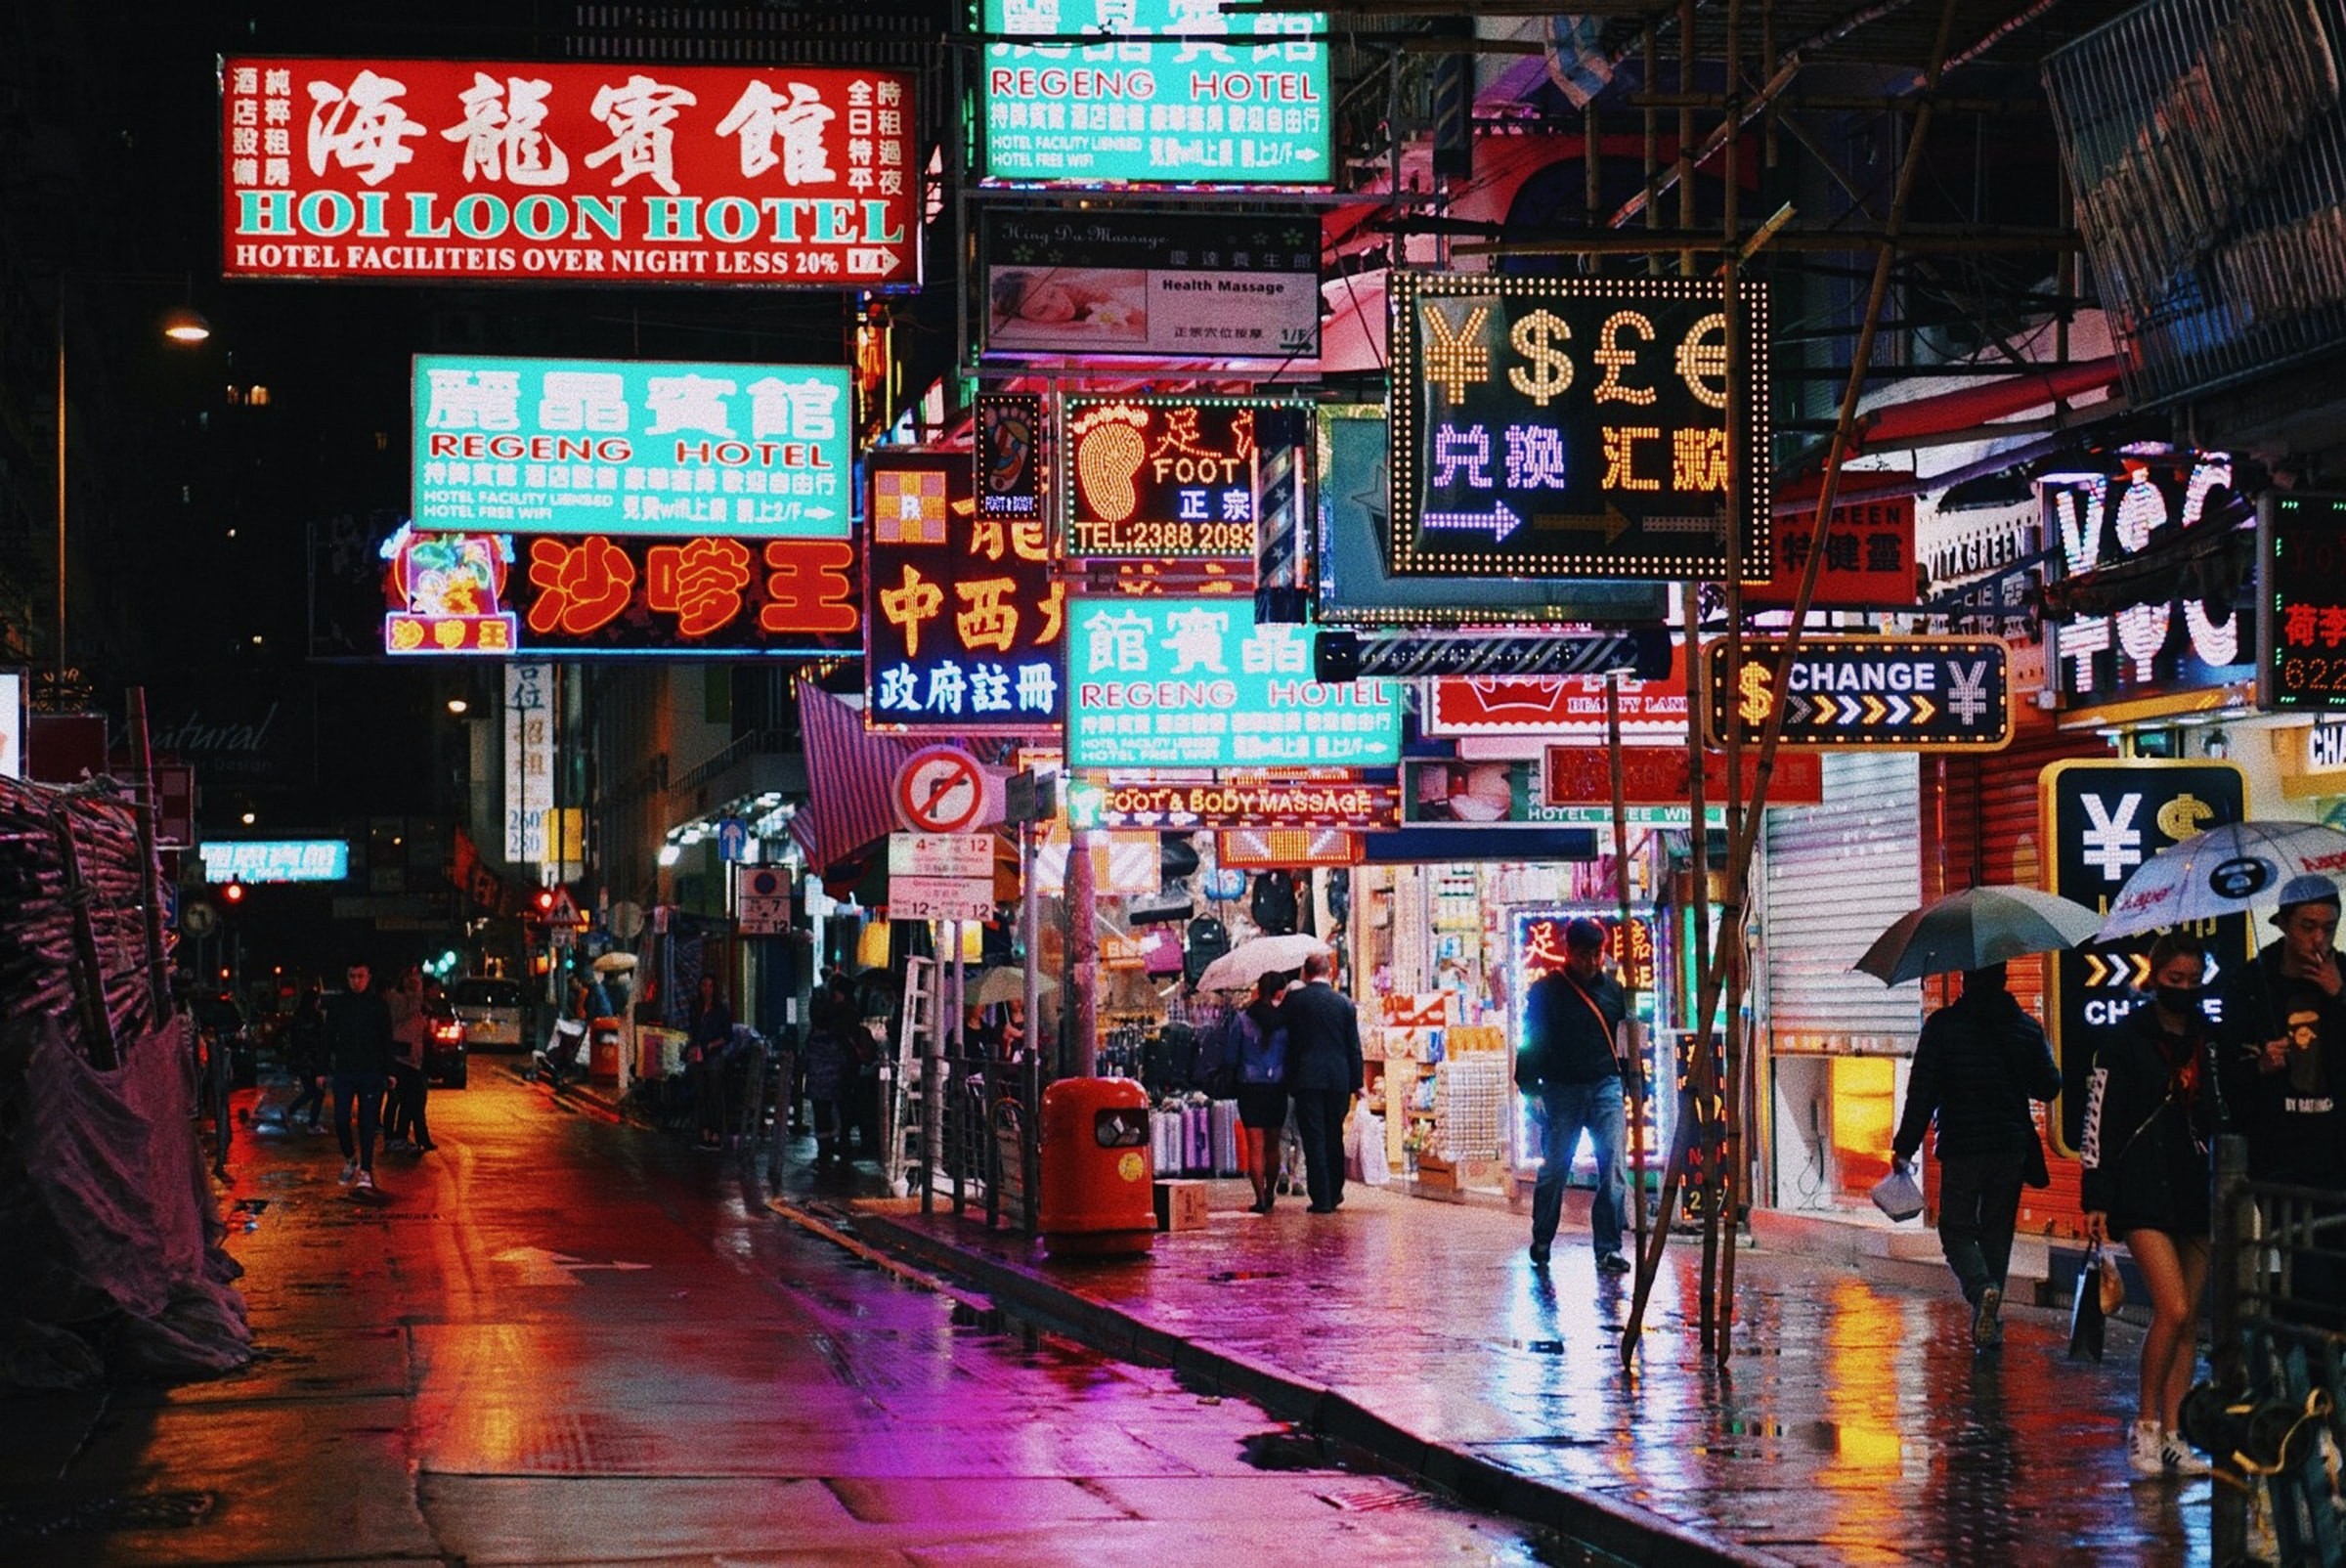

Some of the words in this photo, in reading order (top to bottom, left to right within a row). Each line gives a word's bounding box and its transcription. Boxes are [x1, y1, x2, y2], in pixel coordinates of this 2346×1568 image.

[990, 68, 1154, 99] REGENG
[1191, 72, 1319, 101] HOTEL
[306, 69, 838, 196] 海龍賓館
[236, 191, 389, 238] HOI
[405, 192, 628, 242] LOON
[643, 196, 905, 244] HOTEL
[236, 245, 340, 270] HOTEL
[347, 246, 516, 272] FACILITEIS
[523, 247, 605, 273] OVER
[612, 249, 706, 274] NIGHT
[717, 251, 789, 275] LESS
[795, 252, 839, 275] 20%
[1162, 280, 1212, 291] Health
[1218, 281, 1284, 295] Massage
[424, 369, 841, 441] 麗晶賓館
[427, 434, 633, 462] REGENG
[675, 438, 834, 469] HOTEL
[1152, 457, 1240, 484] FOOT
[1180, 489, 1251, 521] 正宗
[880, 660, 1058, 715] 政府註冊
[1789, 663, 1935, 690] CHANGE
[1080, 681, 1238, 709] REGENG
[1268, 679, 1391, 707] HOTEL
[1567, 696, 1642, 714] BEATY
[1190, 790, 1257, 814] BODY
[1261, 789, 1372, 814] MASSAGE
[1528, 807, 1589, 821] HOTEL
[1603, 807, 1652, 821] FEE
[973, 904, 989, 918] 12
